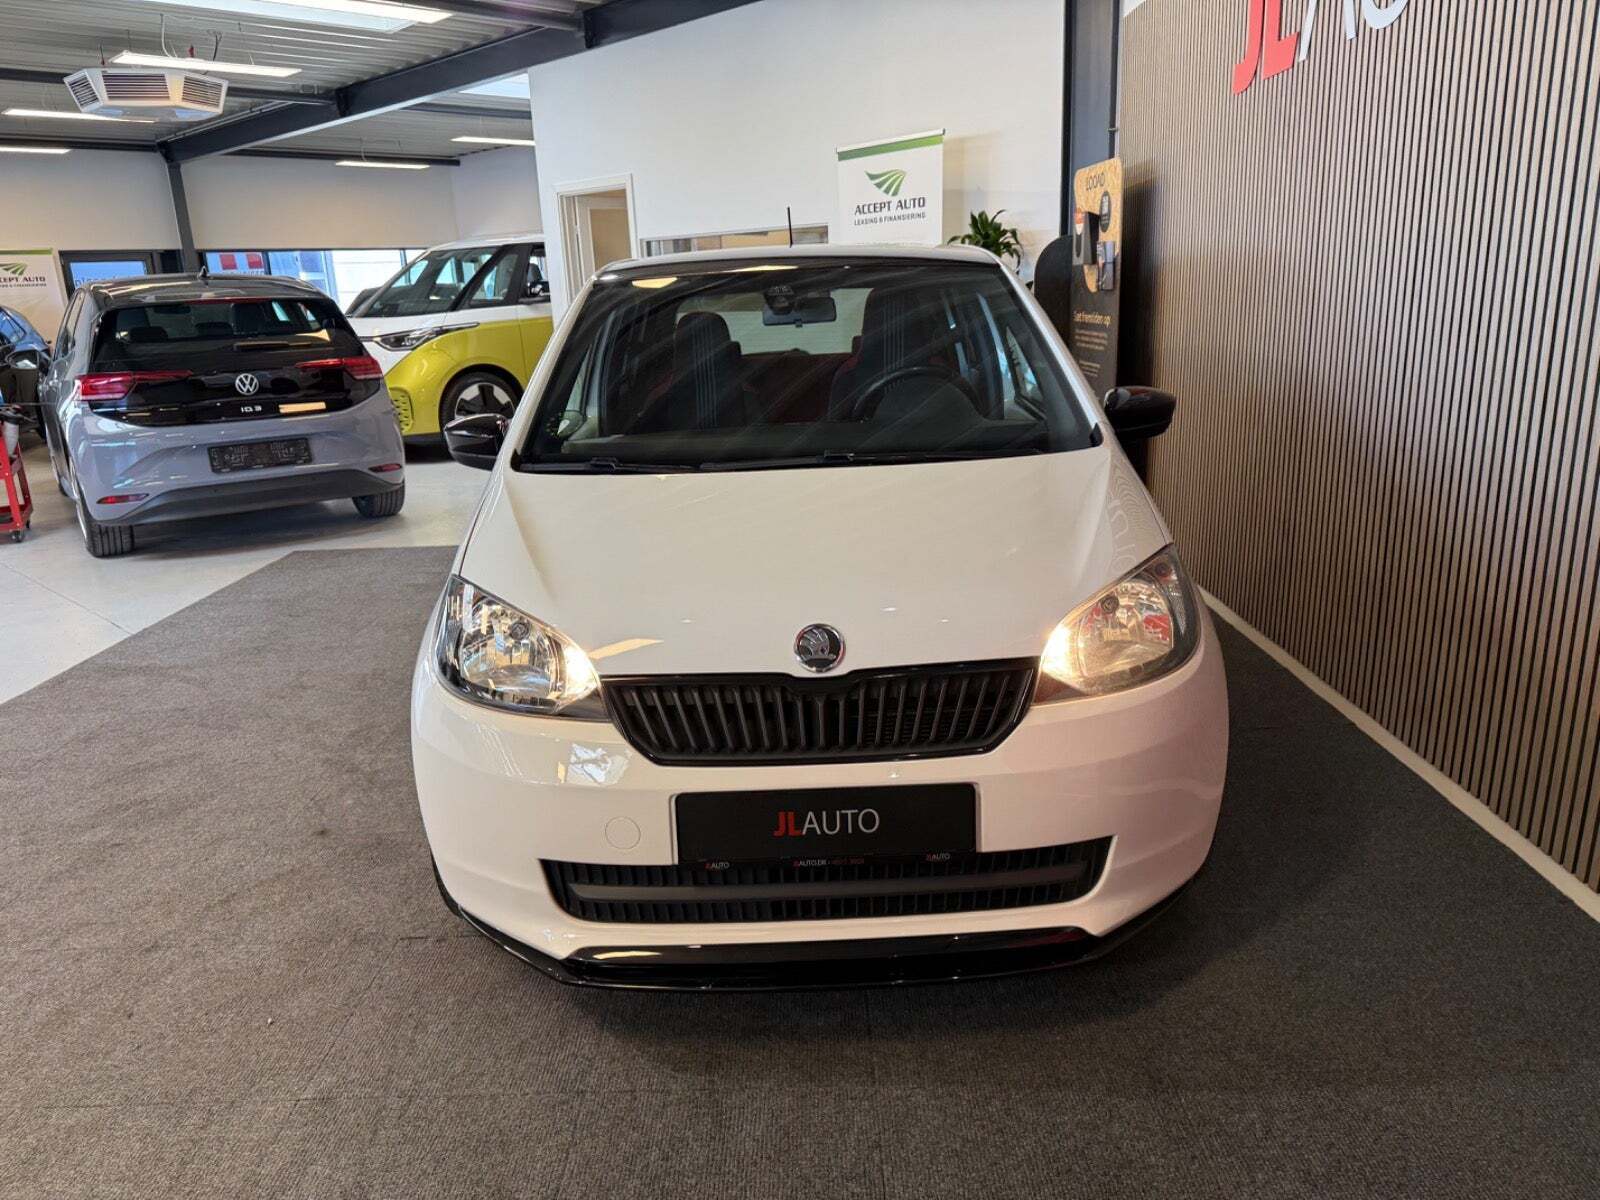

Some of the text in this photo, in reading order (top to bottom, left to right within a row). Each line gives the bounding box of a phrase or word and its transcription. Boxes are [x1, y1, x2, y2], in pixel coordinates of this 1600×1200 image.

[854, 196, 926, 215] ACCEPT AUTO
[854, 217, 878, 226] LEASING
[772, 808, 880, 837] JLAUTO
